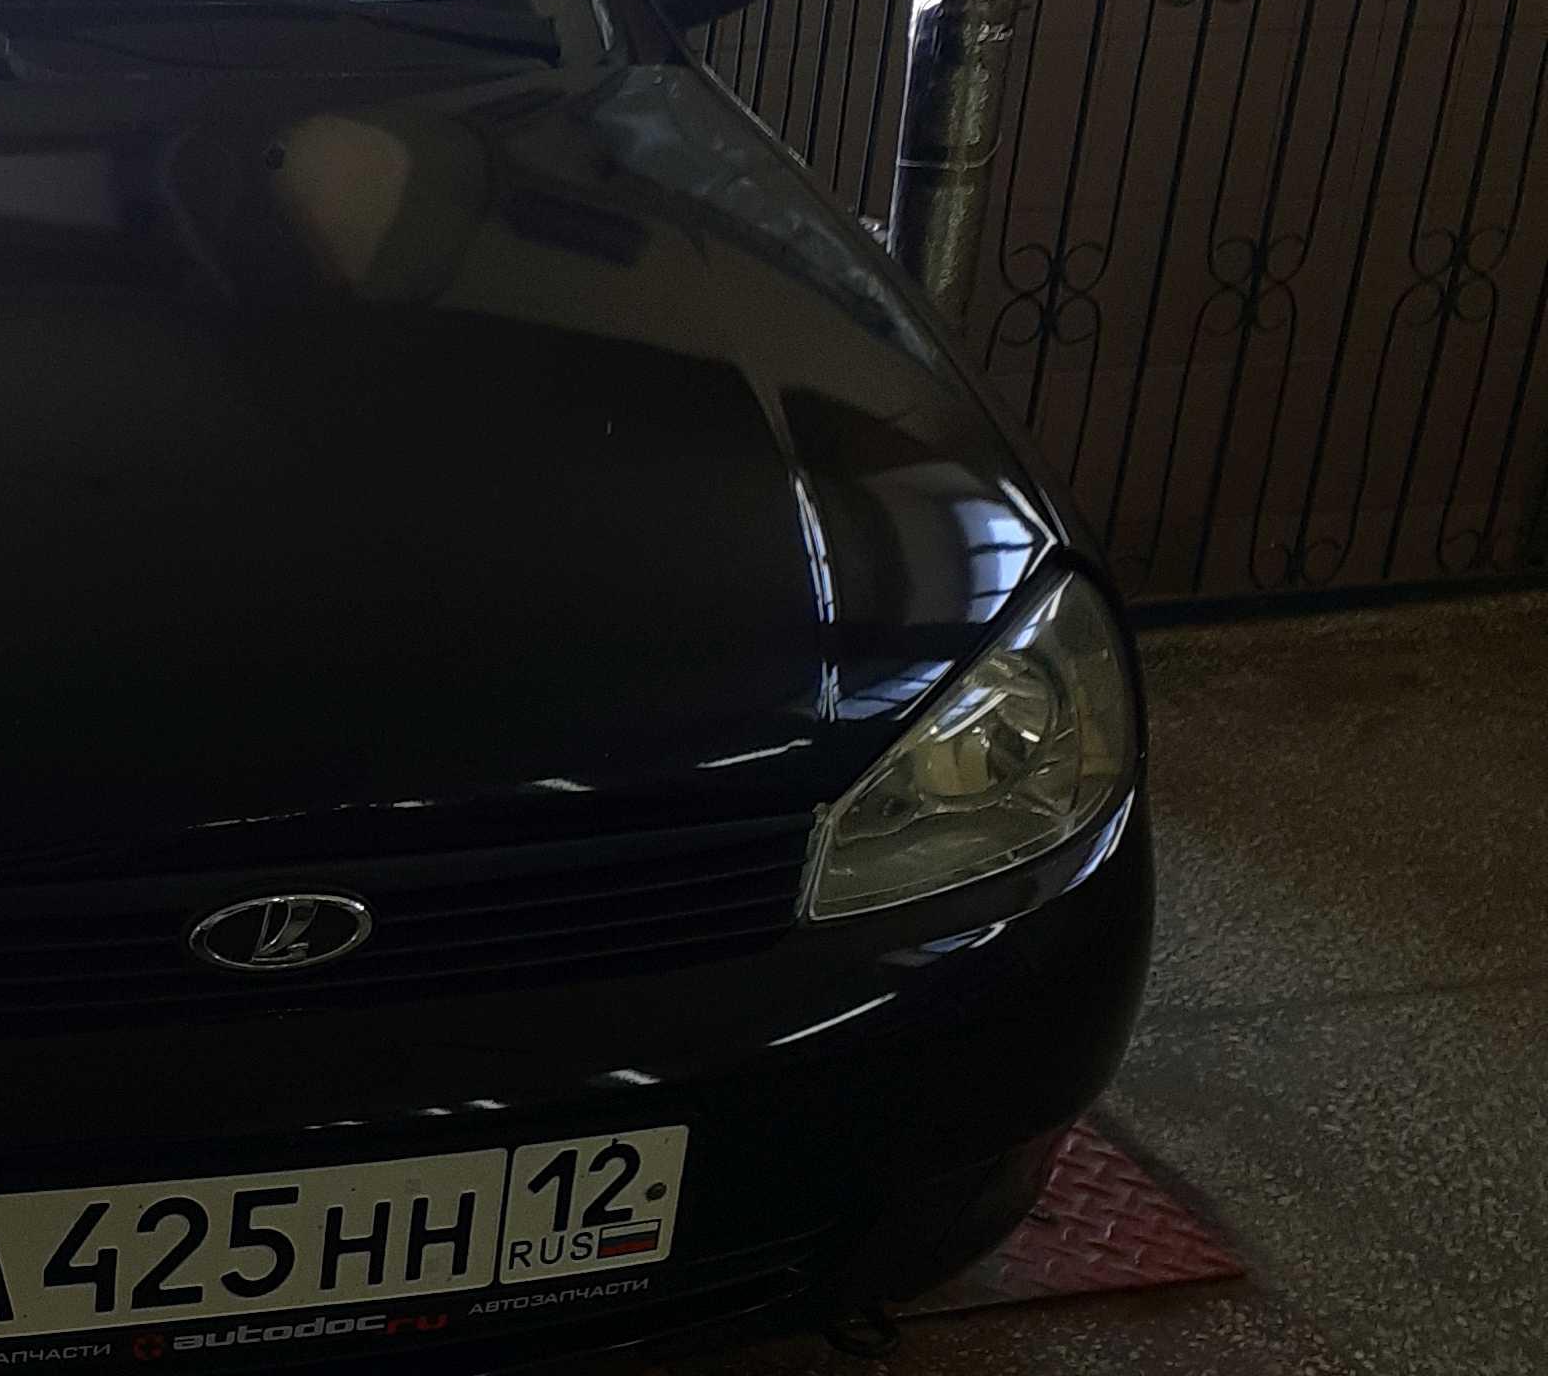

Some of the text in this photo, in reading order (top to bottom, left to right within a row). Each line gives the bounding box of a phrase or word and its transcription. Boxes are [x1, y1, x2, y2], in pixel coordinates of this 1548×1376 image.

[528, 1142, 640, 1231] 12
[508, 1231, 593, 1270] RUS
[467, 1277, 650, 1316] АВТОЗАПЧАСТИ
